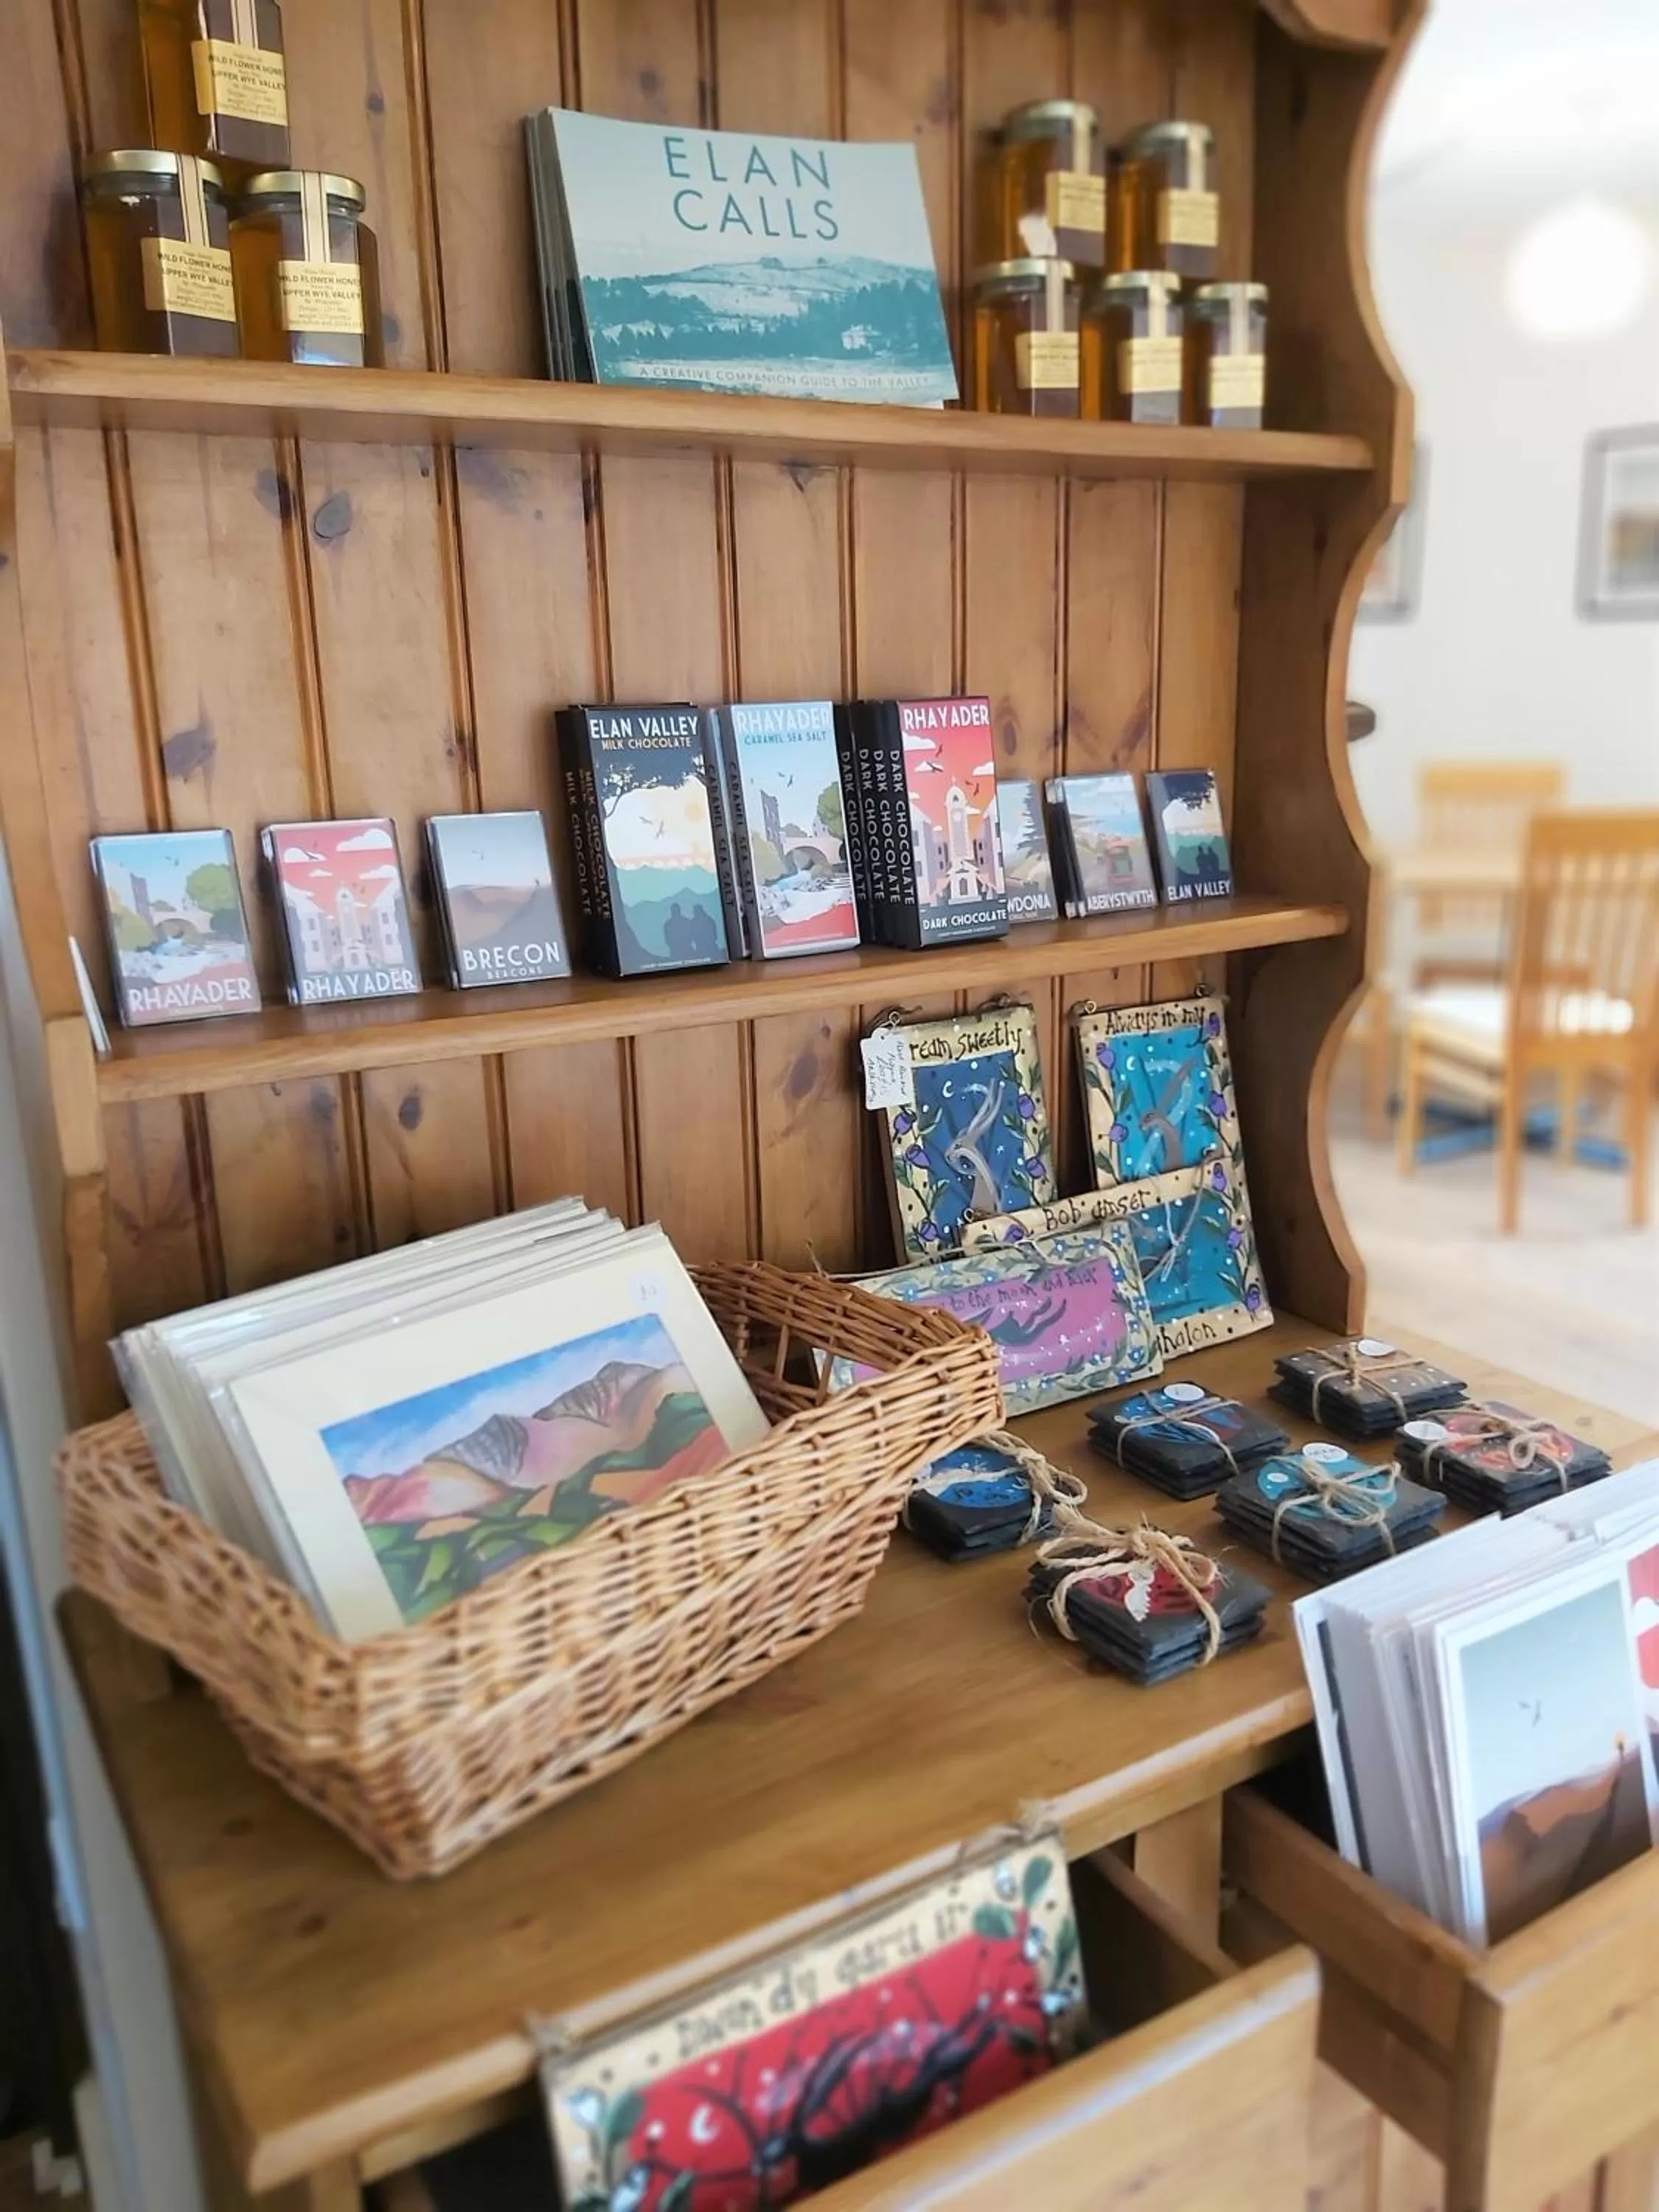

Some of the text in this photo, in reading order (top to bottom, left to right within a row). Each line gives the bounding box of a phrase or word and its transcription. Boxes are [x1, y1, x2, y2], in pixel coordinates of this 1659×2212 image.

[229, 58, 260, 71] FLOWER
[240, 76, 256, 85] WYE
[663, 136, 832, 190] ELAN
[672, 189, 839, 241] CALLS
[179, 256, 210, 268] FLOWER
[190, 273, 206, 282] WYE
[300, 274, 333, 283] FLOWER
[312, 290, 327, 298] WYE
[640, 367, 929, 389] A CREATIVE COMPANION GUIDE TO THE VALLEY
[590, 716, 698, 739] ELAN VALLEY
[738, 706, 830, 733] RHAYADER
[903, 704, 990, 731] RHAYADER
[602, 737, 692, 751] MILK CHOCOLATE
[743, 731, 827, 745] CARAMEL SEA SALT
[841, 751, 866, 900] DARK CHOCOLATE
[859, 748, 885, 900] DARK CHOCOLATE
[874, 750, 901, 904] DARK CHOCOLATE
[890, 750, 916, 905] DARK CHOCOLATE
[572, 813, 592, 916] CHOCOLATE
[591, 813, 611, 919] CHOCOLATE
[1087, 888, 1155, 911] ABERYSTWYTH
[1167, 880, 1231, 901] ELAN VALLEY
[1007, 893, 1051, 914] WDONIA
[922, 917, 947, 931] DARK
[951, 909, 1008, 926] CHOCOLATE
[463, 941, 562, 971] BRECON
[303, 967, 417, 1001] RHAYADER
[487, 966, 543, 980] BEACONS
[128, 977, 252, 1012] RHAYADER
[1105, 1006, 1208, 1048] Always in my
[909, 1037, 953, 1061] ream
[1043, 1198, 1081, 1231] Bob
[950, 1296, 964, 1312] to
[967, 1290, 991, 1309] the
